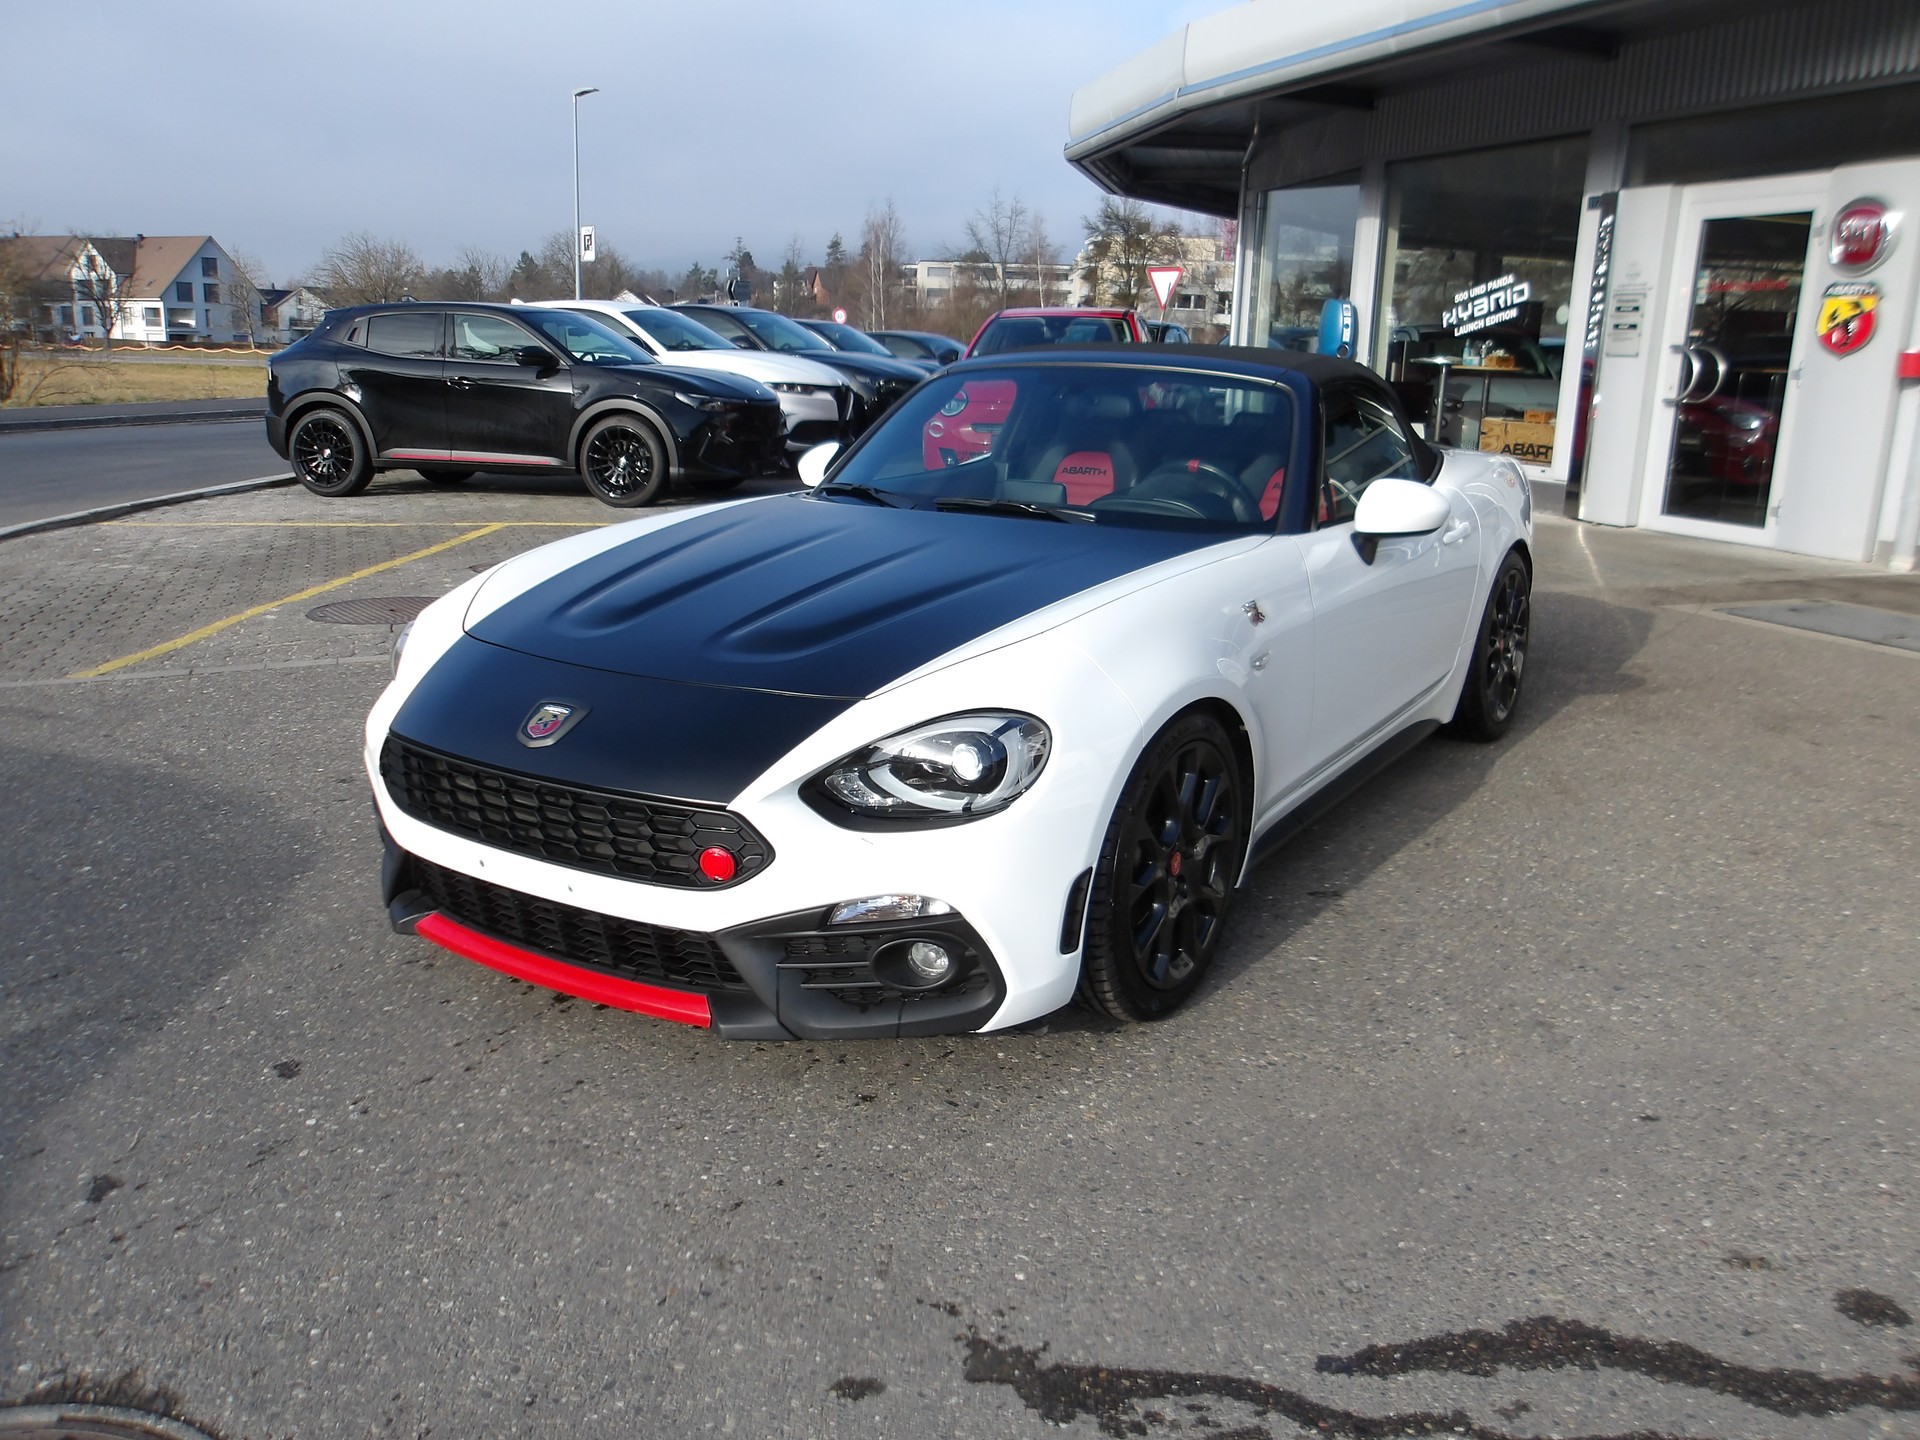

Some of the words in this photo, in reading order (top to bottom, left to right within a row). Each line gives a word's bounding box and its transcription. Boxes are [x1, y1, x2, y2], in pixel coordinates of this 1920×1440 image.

[1469, 283, 1487, 298] UND
[1487, 273, 1515, 292] PANDA
[1442, 281, 1530, 329] HYBRID
[1454, 319, 1485, 337] LAUNCH
[1485, 306, 1518, 327] EDITION
[1061, 466, 1107, 477] ABARTH
